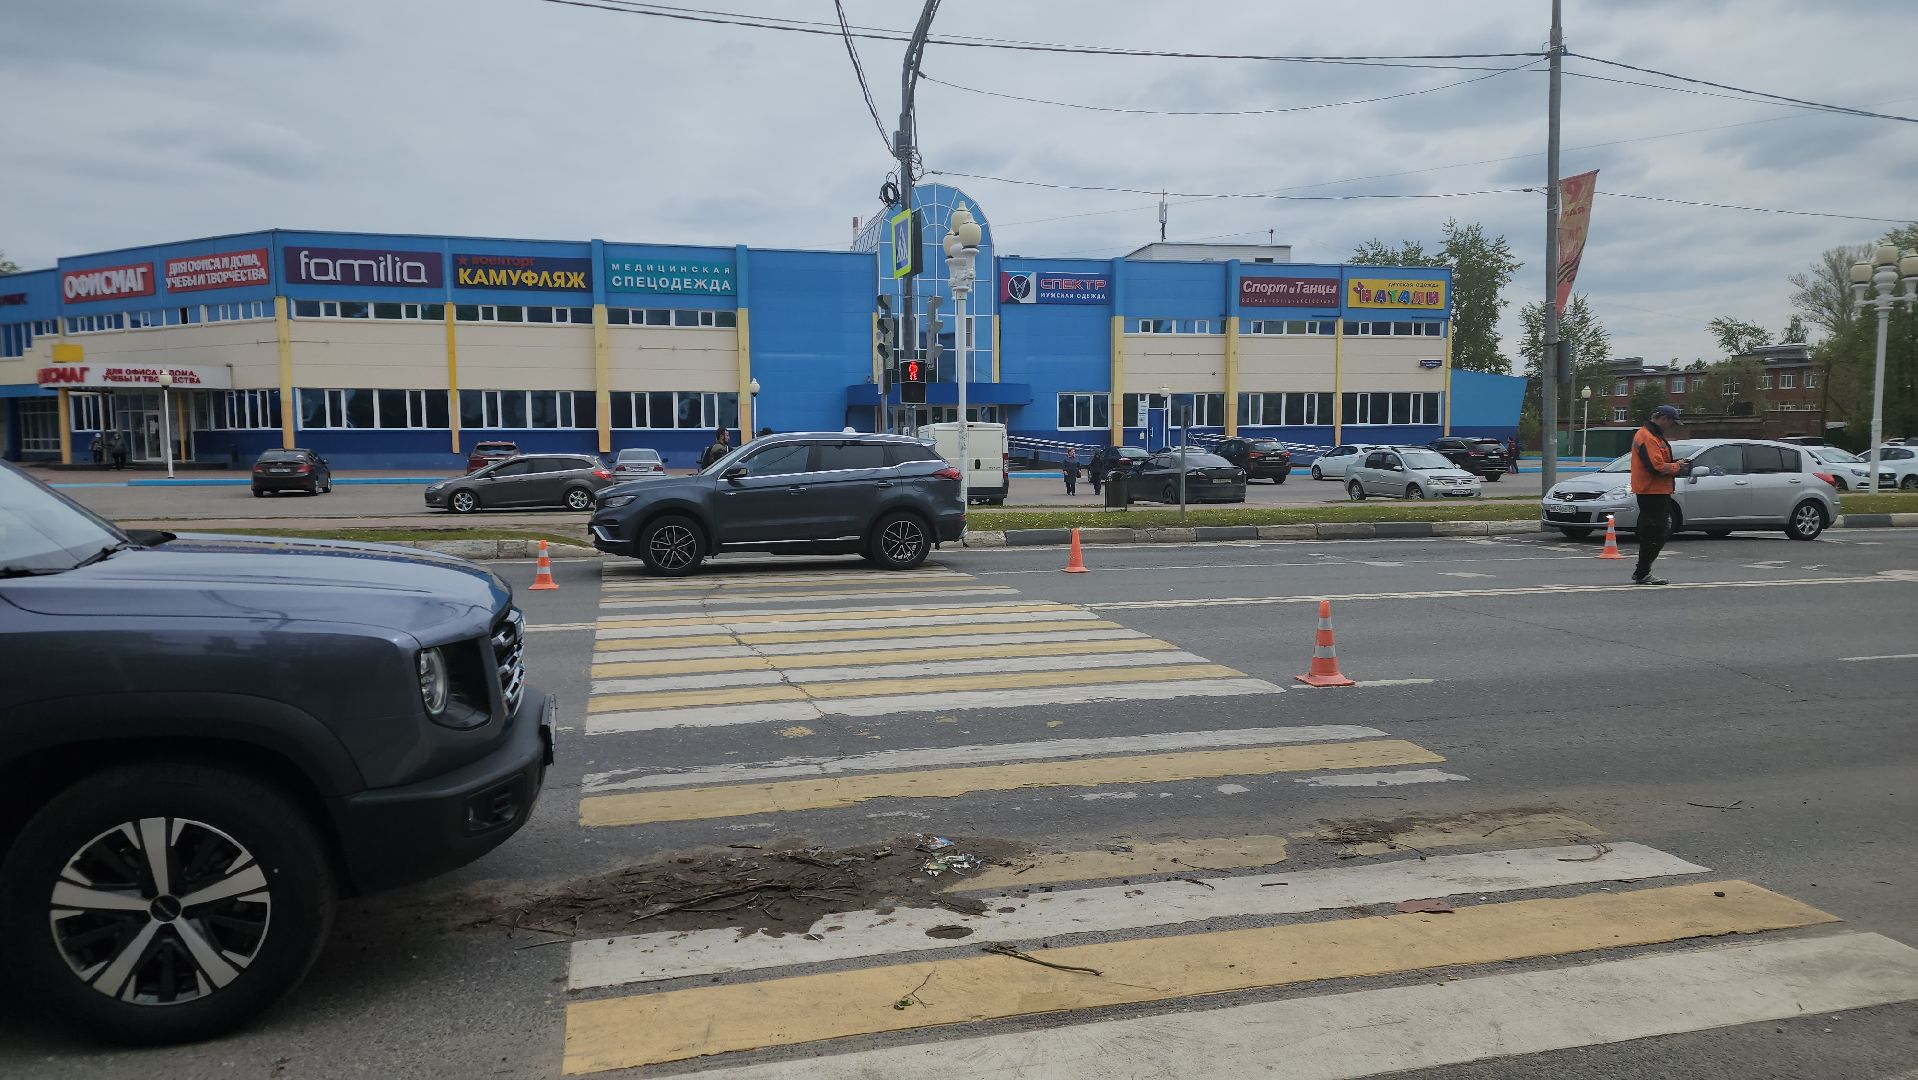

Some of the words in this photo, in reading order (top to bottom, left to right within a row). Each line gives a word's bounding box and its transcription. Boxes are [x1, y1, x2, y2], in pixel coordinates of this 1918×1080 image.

[169, 261, 187, 277] ДЛЯ
[187, 257, 222, 272] ОФИСА
[222, 256, 230, 269] И
[230, 253, 261, 270] ДОМА,
[299, 250, 428, 284] familia
[611, 263, 731, 275] МЕДИЦИНСКАЯ
[63, 267, 149, 300] ОФИСМАГ
[166, 275, 198, 289] УЧЕБЫ
[197, 273, 206, 286] И
[206, 267, 267, 285] ТВОРЧЕСТВА
[458, 267, 587, 289] КАМУФЛЯЖ
[611, 275, 731, 293] СПЕЦОДЕЖДА
[1040, 278, 1107, 291] СПЕКТР
[1243, 280, 1288, 296] Спорт
[1295, 281, 1337, 296] Танцы
[1359, 288, 1440, 306] НАТАЛИ
[125, 368, 158, 376] ОФИСА
[168, 369, 198, 378] ДОМА,
[142, 375, 202, 384] ТВОЕСТВА
